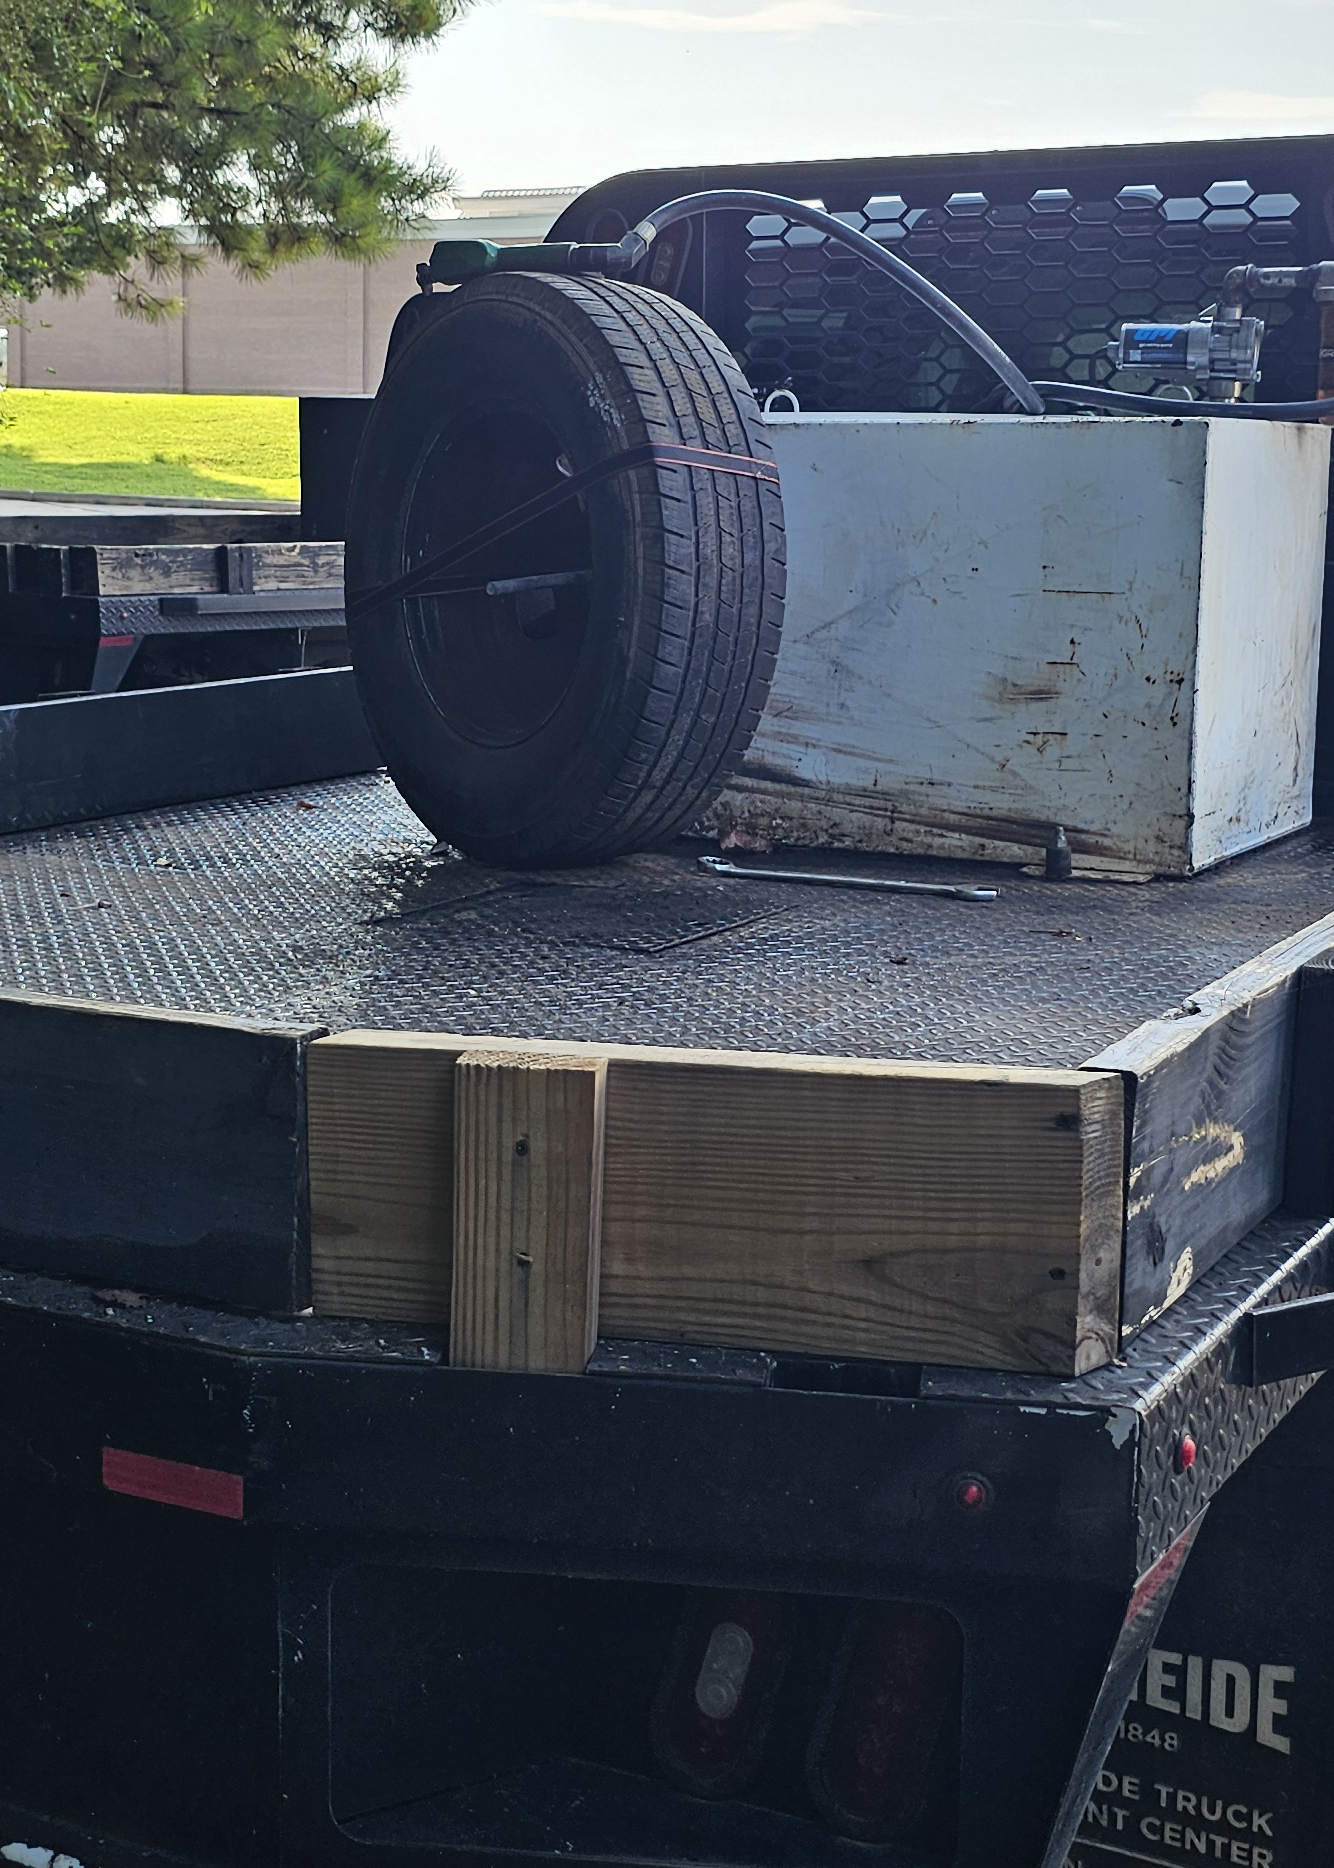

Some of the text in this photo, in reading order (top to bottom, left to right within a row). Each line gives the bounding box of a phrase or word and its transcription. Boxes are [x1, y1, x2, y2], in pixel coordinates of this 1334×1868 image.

[1129, 1648, 1296, 1756] EIDE
[1154, 1782, 1275, 1838] TRUCK
[1139, 1815, 1274, 1868] CENTER
